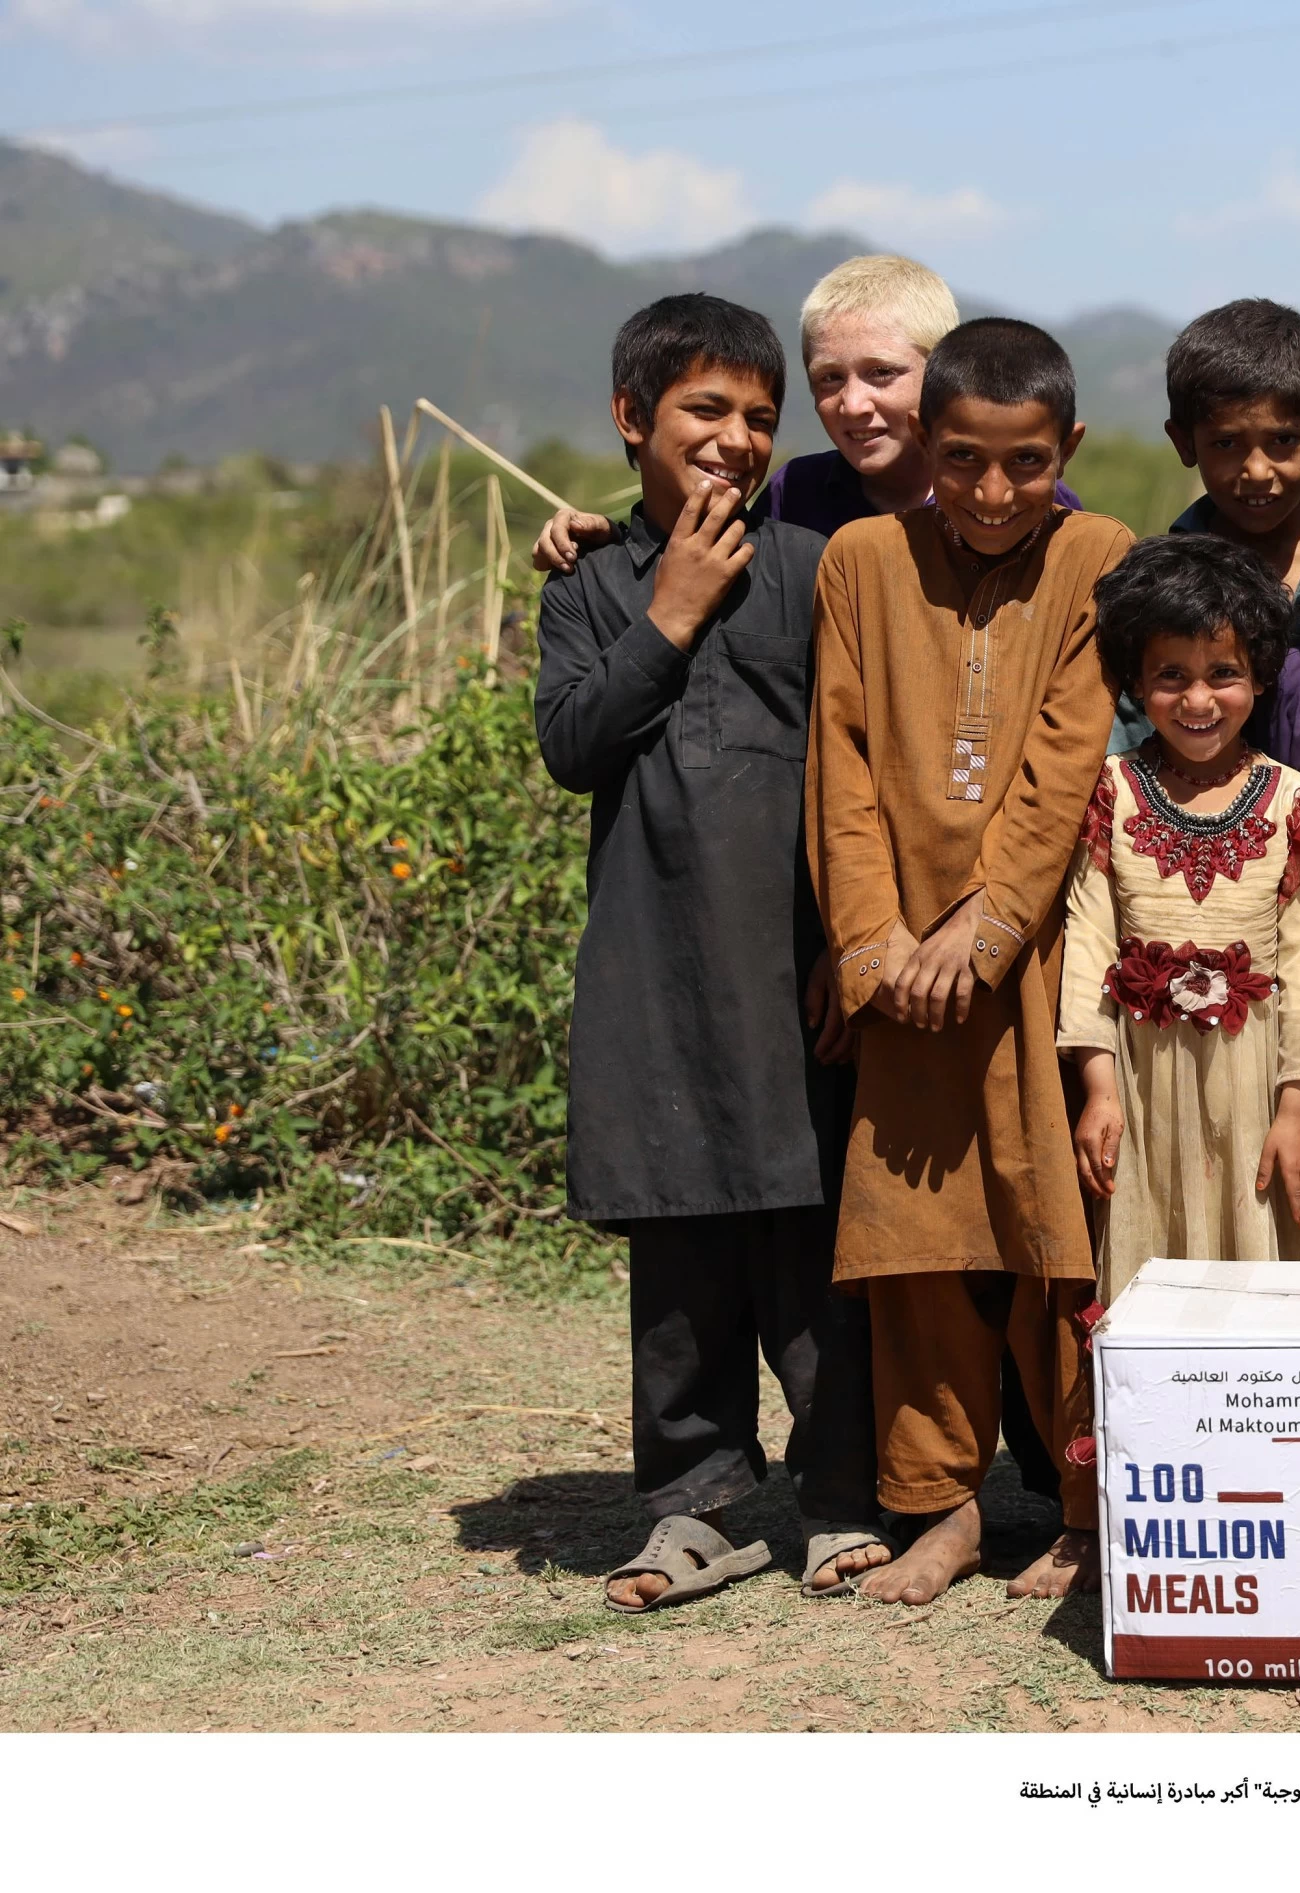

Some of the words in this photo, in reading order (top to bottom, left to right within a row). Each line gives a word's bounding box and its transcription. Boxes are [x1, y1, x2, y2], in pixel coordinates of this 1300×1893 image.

[1171, 1370, 1228, 1384] العالمية
[1238, 1370, 1283, 1385] مكتوم
[1196, 1417, 1213, 1434] Al
[1125, 1463, 1204, 1503] 100
[1125, 1518, 1286, 1559] MILLION
[1126, 1574, 1259, 1615] MEALS
[1205, 1658, 1253, 1678] 100
